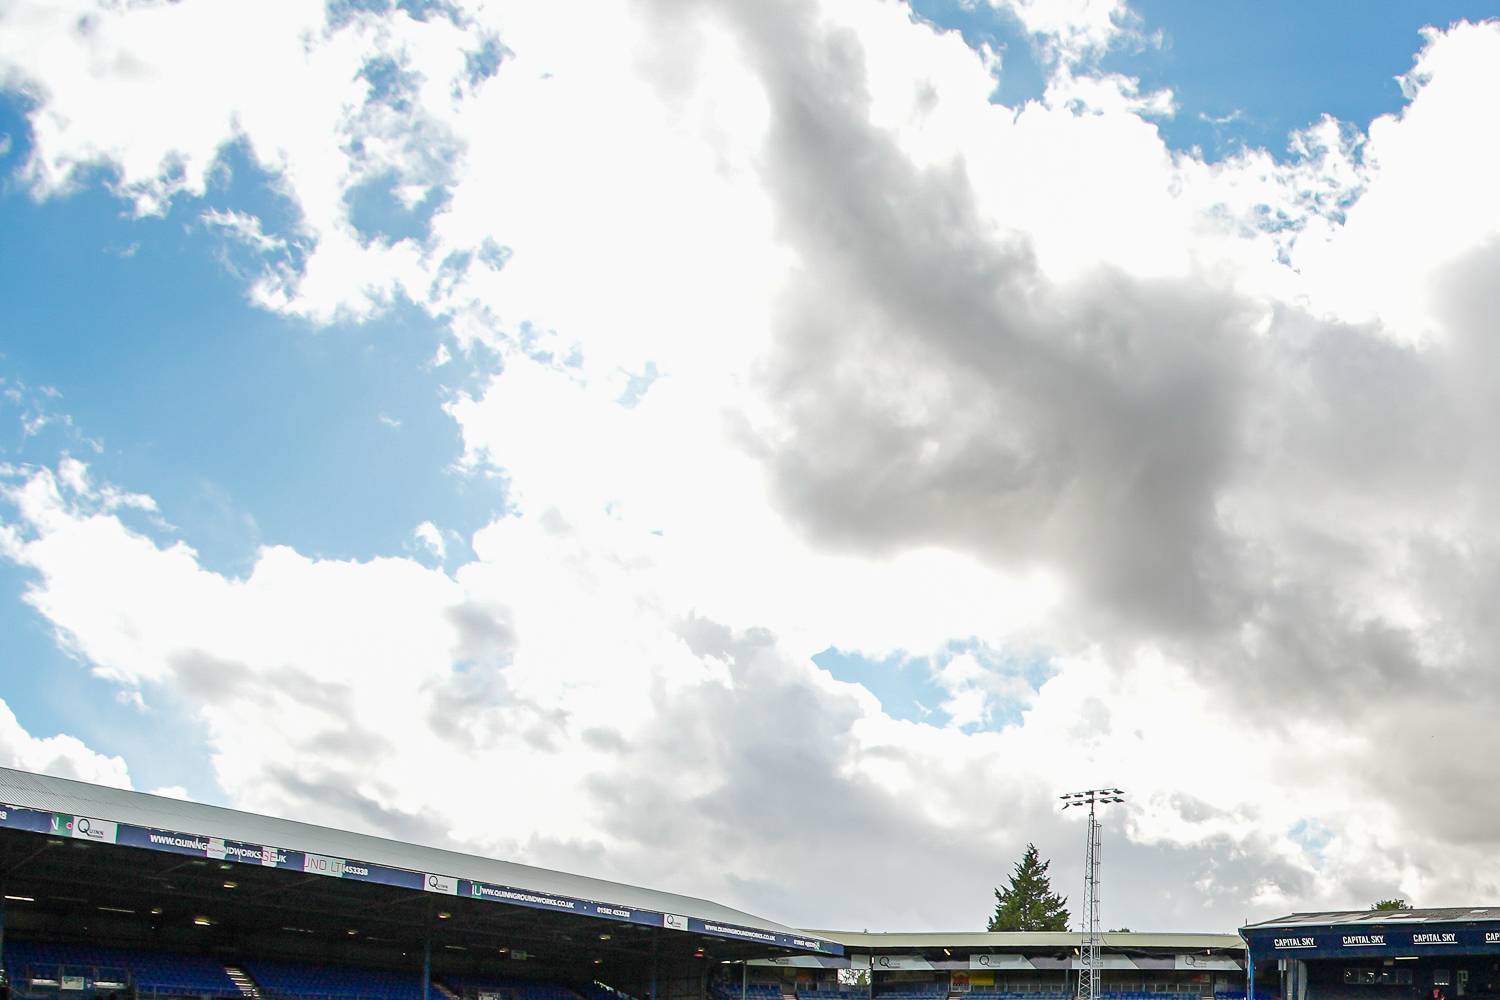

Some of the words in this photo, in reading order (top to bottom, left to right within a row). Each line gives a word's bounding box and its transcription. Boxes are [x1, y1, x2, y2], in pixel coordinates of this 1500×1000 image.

[1274, 938, 1300, 947] CAPITAL
[1301, 938, 1315, 946] SKY
[1342, 936, 1369, 945] CAPITAL
[1370, 935, 1384, 943] SKY
[1413, 934, 1440, 943] CAPITAL
[1441, 933, 1456, 942] SKY
